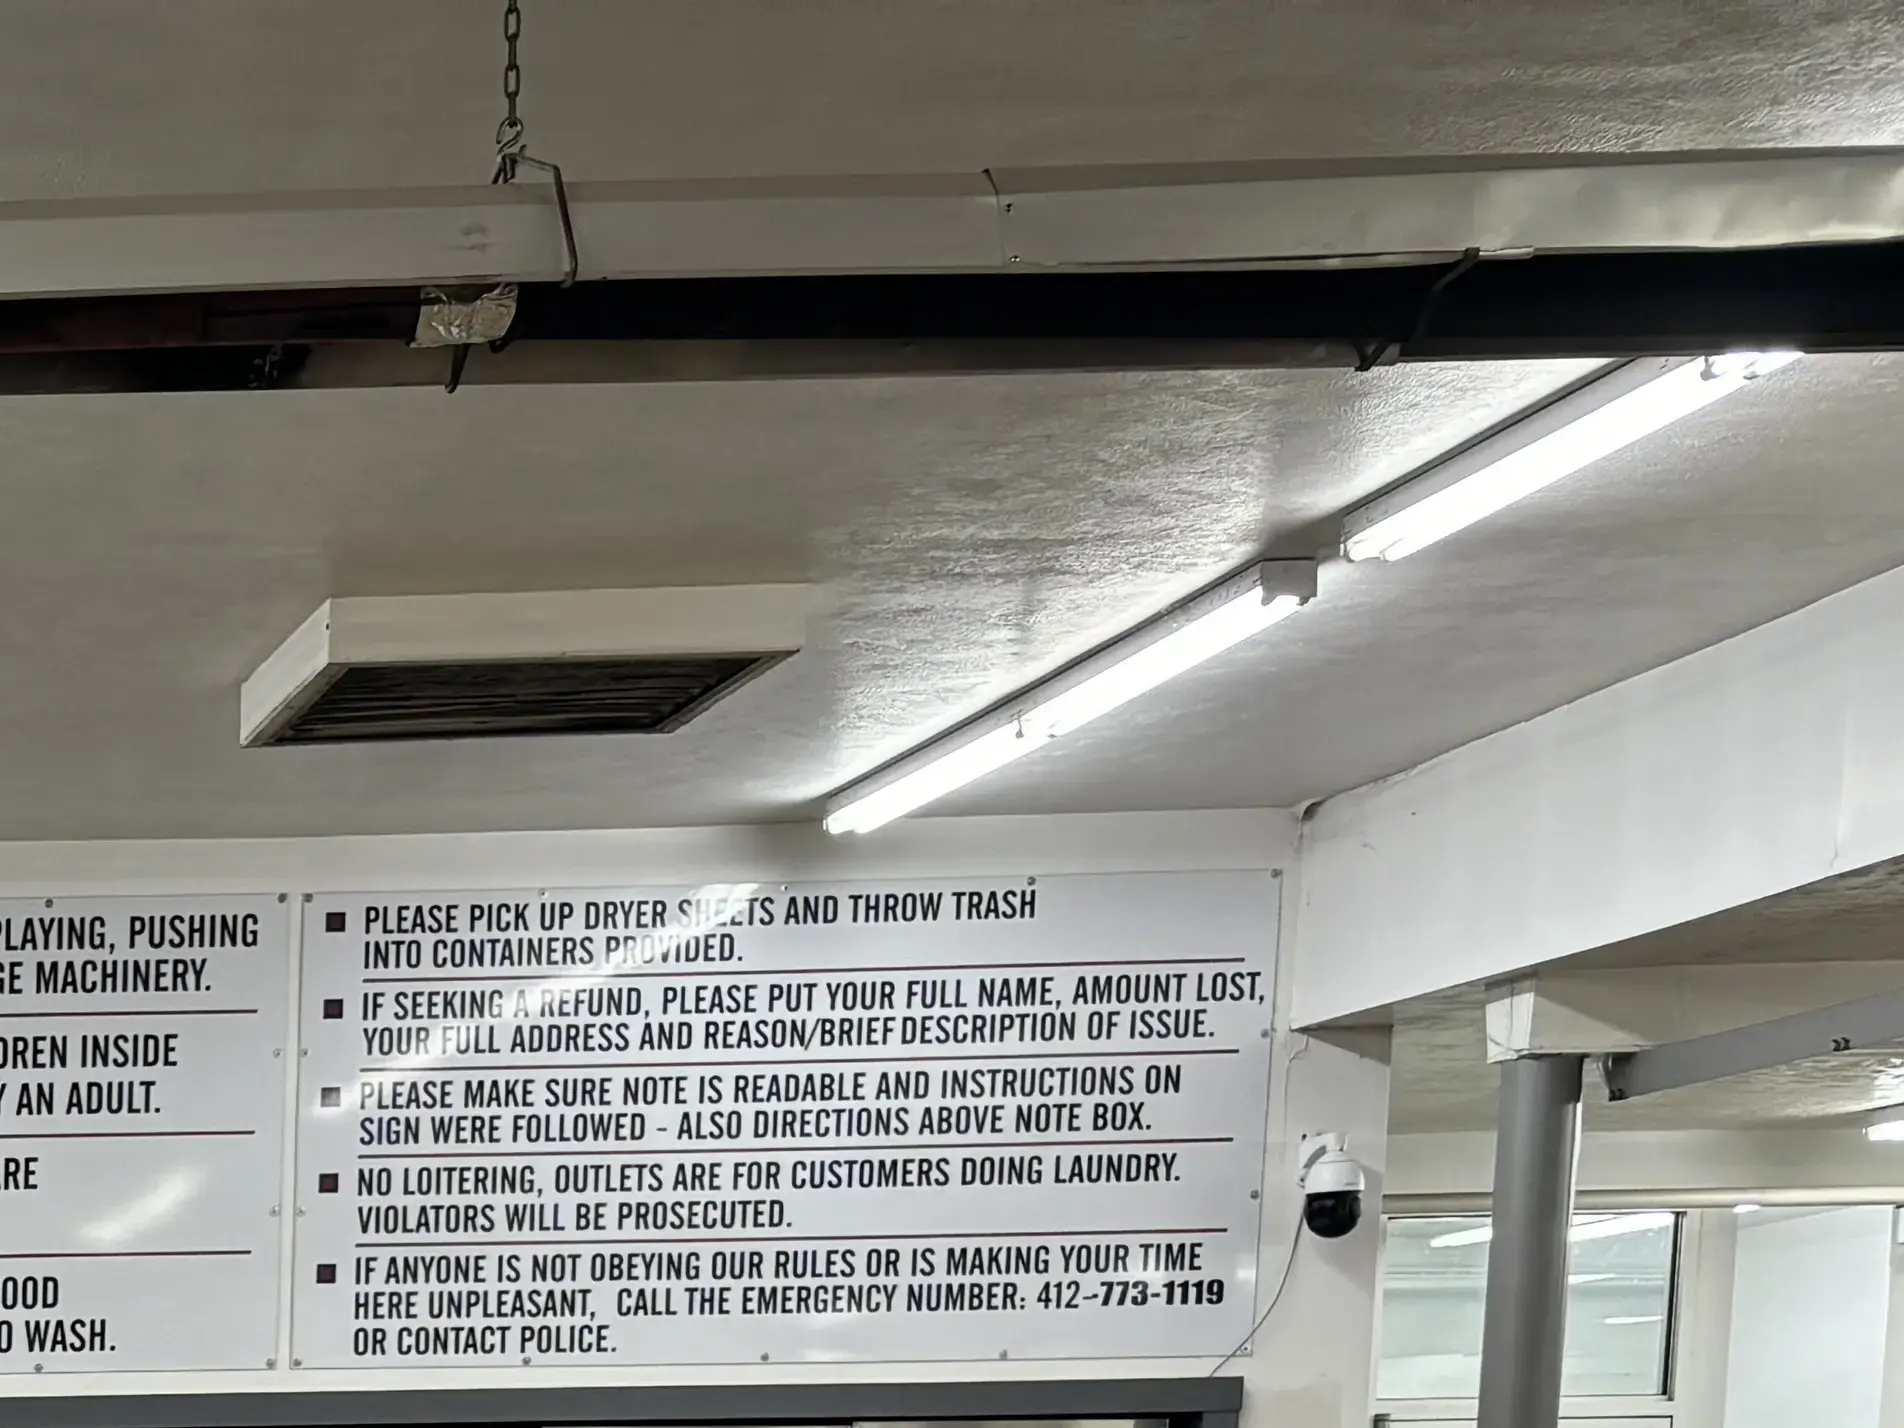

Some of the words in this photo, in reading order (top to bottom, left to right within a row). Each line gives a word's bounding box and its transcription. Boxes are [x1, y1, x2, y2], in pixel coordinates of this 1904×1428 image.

[81, 1034, 178, 1068] INSIDE
[358, 1168, 391, 1196] NO
[403, 1165, 542, 1197] LOITERING,
[555, 1164, 663, 1193] OUTLETS
[673, 1163, 722, 1191] ARE
[733, 1161, 780, 1190] FOR
[792, 1158, 950, 1189] CUSTOMERS
[961, 1156, 1042, 1185] DOING
[1054, 1153, 1180, 1183] LAUNDRY.
[358, 1204, 495, 1234] VIOLATORS
[505, 1204, 565, 1232] WILL
[576, 1203, 607, 1230] BE
[618, 1200, 792, 1230] PROSECUTED.
[355, 1291, 418, 1320] HERE
[429, 1289, 595, 1321] UNPLEASANT,
[617, 1288, 677, 1316] CALL
[684, 1287, 731, 1315] THE
[742, 1284, 897, 1314] EMERGENCY
[907, 1282, 1025, 1311] NUMBER:
[25, 1319, 115, 1352] WASH.
[354, 1328, 386, 1356] OR
[398, 1326, 511, 1355] CONTACT
[520, 1325, 616, 1353] POLICE.
